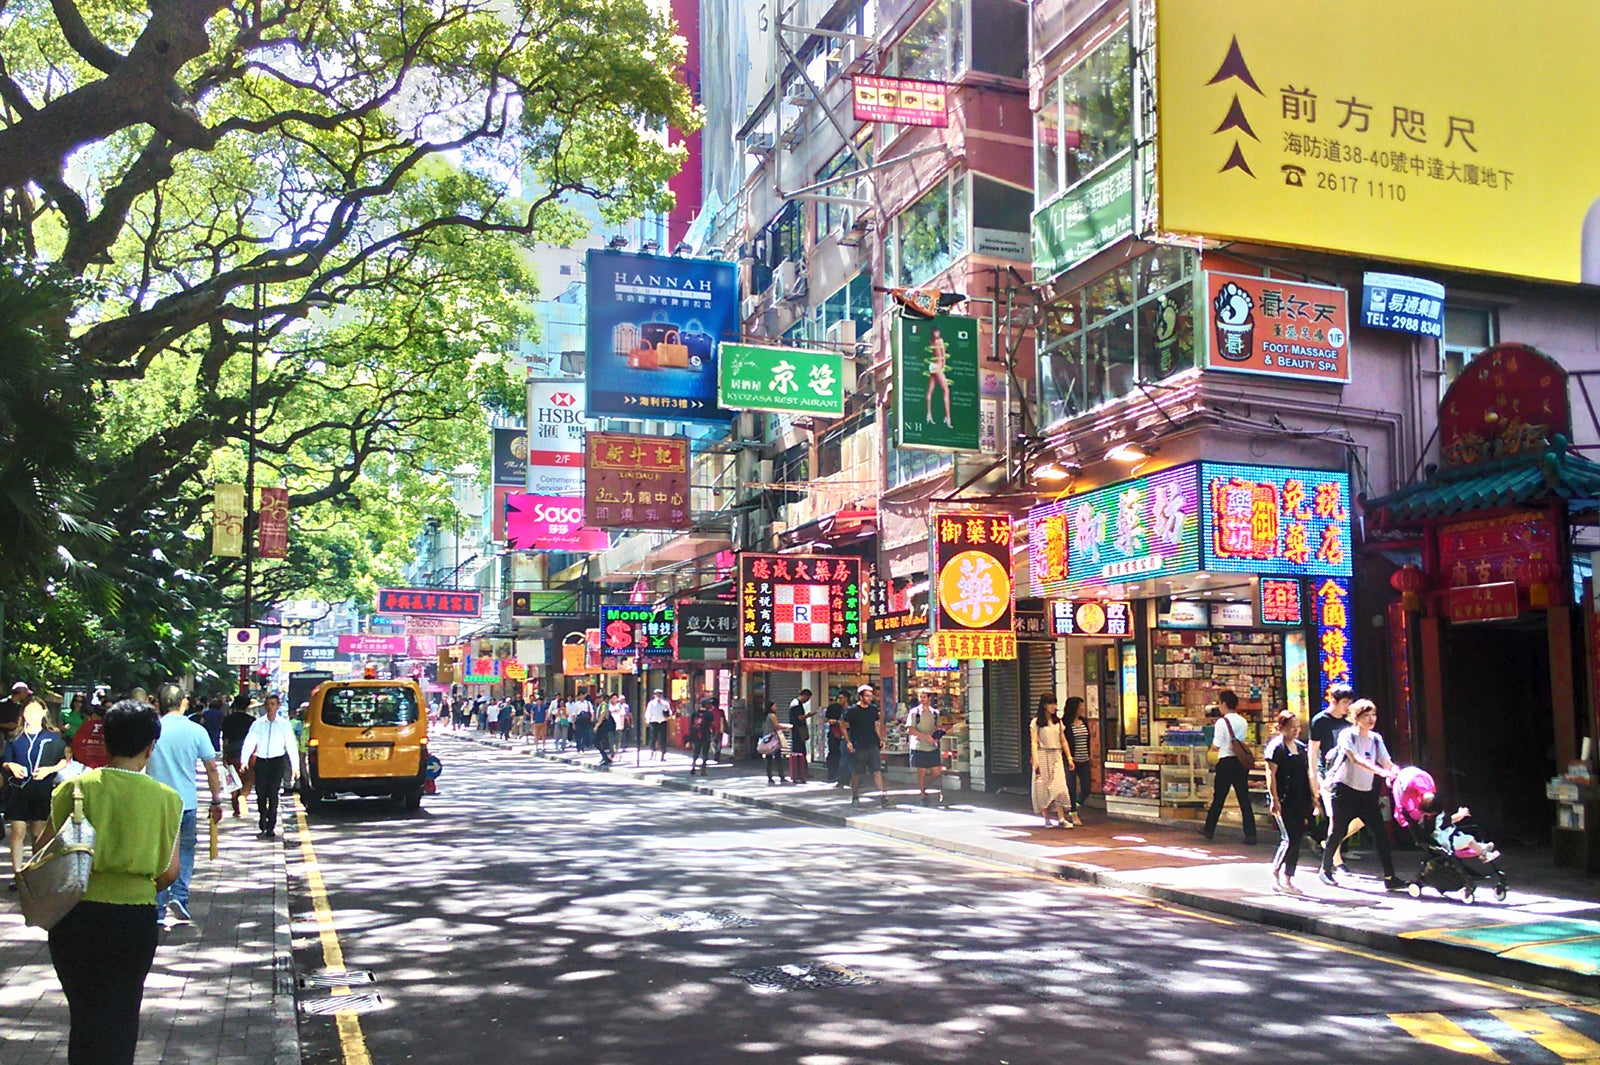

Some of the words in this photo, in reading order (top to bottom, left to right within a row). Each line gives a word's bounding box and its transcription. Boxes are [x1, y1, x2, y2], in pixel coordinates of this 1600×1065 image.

[1279, 84, 1479, 153] 前方咫尺
[1283, 130, 1515, 192] 海防道38-40號中達大廈地下
[1317, 171, 1358, 195] 2617
[1368, 180, 1406, 202] 1110
[615, 272, 711, 291] HANNAH
[1388, 293, 1441, 320] 易通集團
[1366, 312, 1389, 327] TEL:
[1392, 315, 1419, 331] 2988
[1420, 321, 1441, 337] 8348
[1329, 332, 1343, 343] 1/F
[1264, 355, 1272, 365] &
[538, 408, 587, 424] HSBC
[555, 455, 571, 464] 2/F
[606, 446, 673, 464] 新斗記
[540, 475, 582, 484] Commerci
[622, 490, 684, 505] 九龍中心
[940, 518, 1011, 546] 御藥坊
[950, 557, 1000, 621] 藥
[607, 610, 657, 622] Money
[1318, 579, 1349, 700] 全國特快
[247, 656, 257, 664] 12
[748, 650, 767, 659] TAK
[769, 651, 800, 659] SHING
[802, 651, 855, 660] PHARMACY
